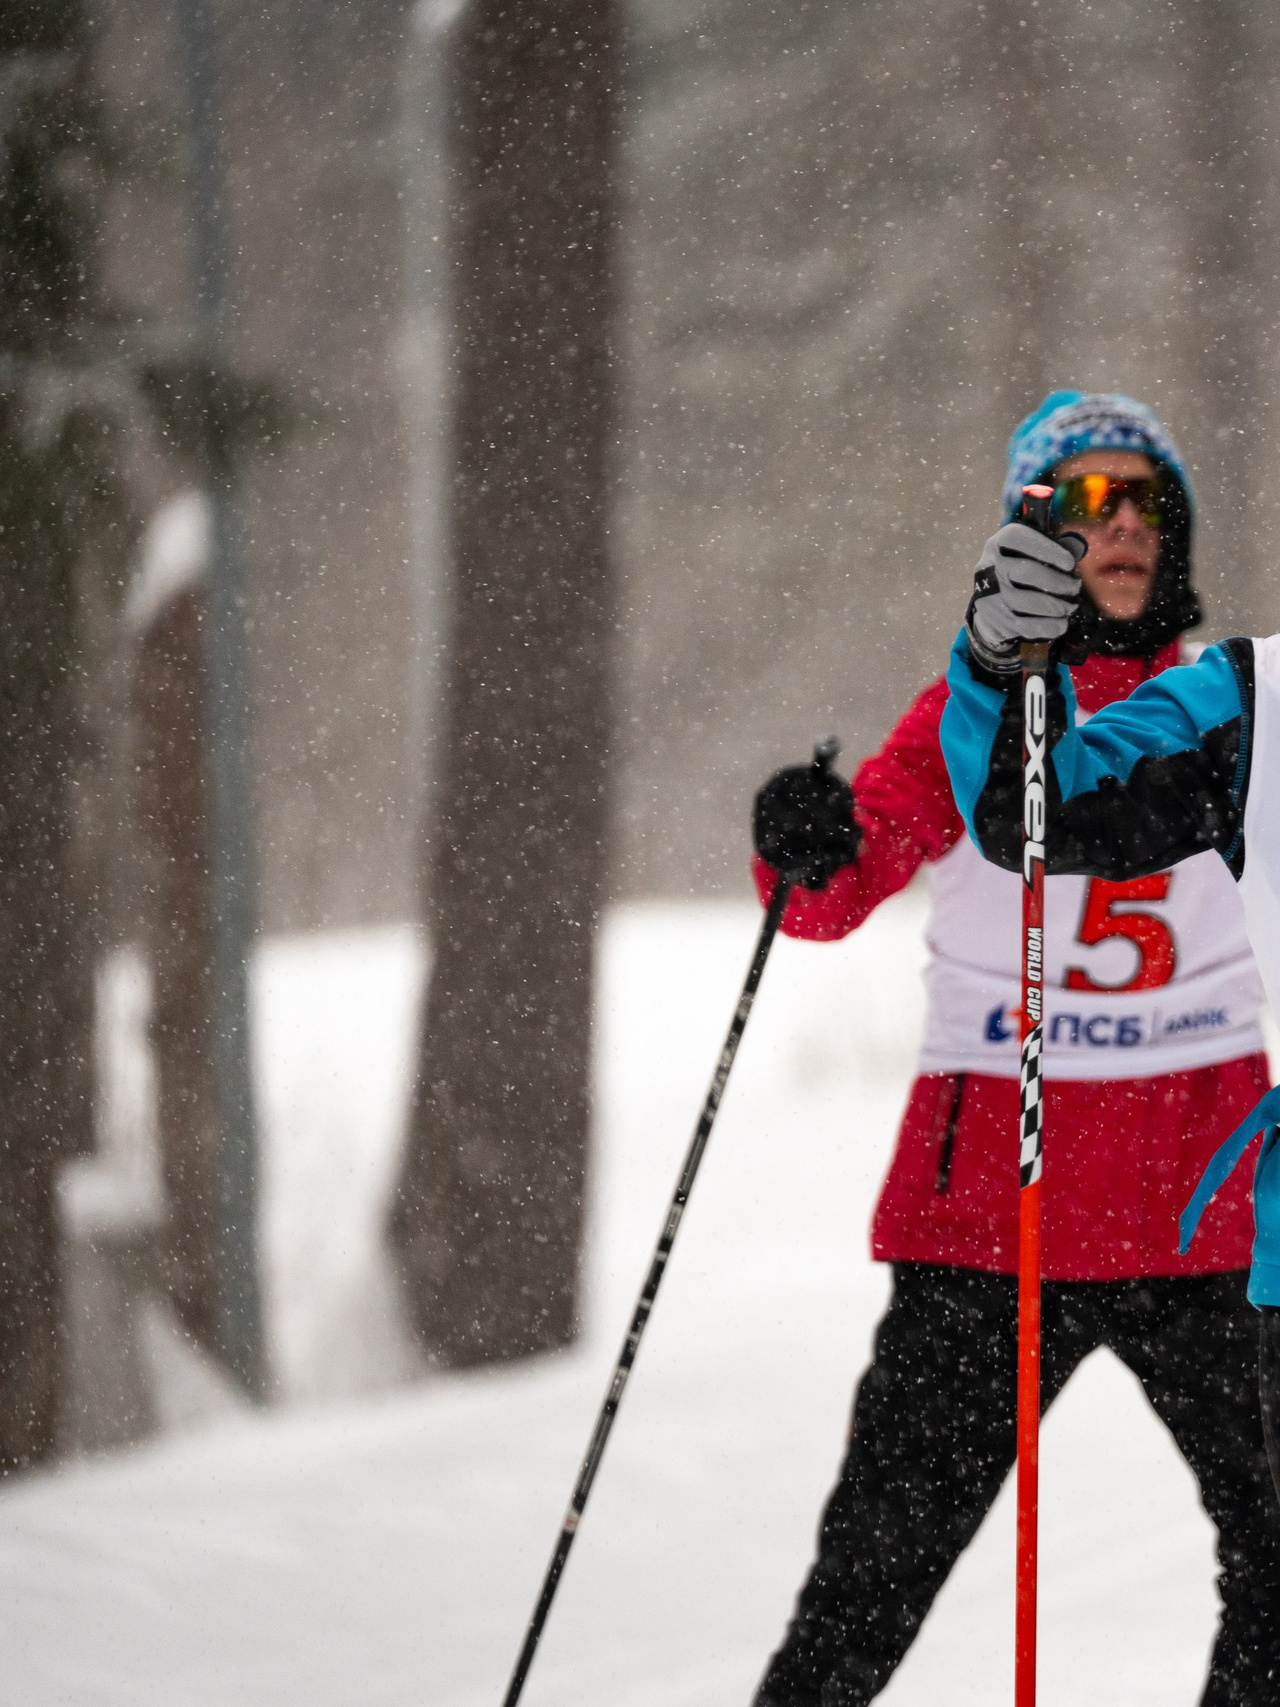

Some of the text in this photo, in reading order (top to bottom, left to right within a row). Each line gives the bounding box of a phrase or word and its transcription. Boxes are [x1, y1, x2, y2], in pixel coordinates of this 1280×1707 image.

[1027, 927, 1043, 1022] WORLD CUP
[1063, 870, 1177, 994] 5
[1050, 1011, 1142, 1047] ПСБ
